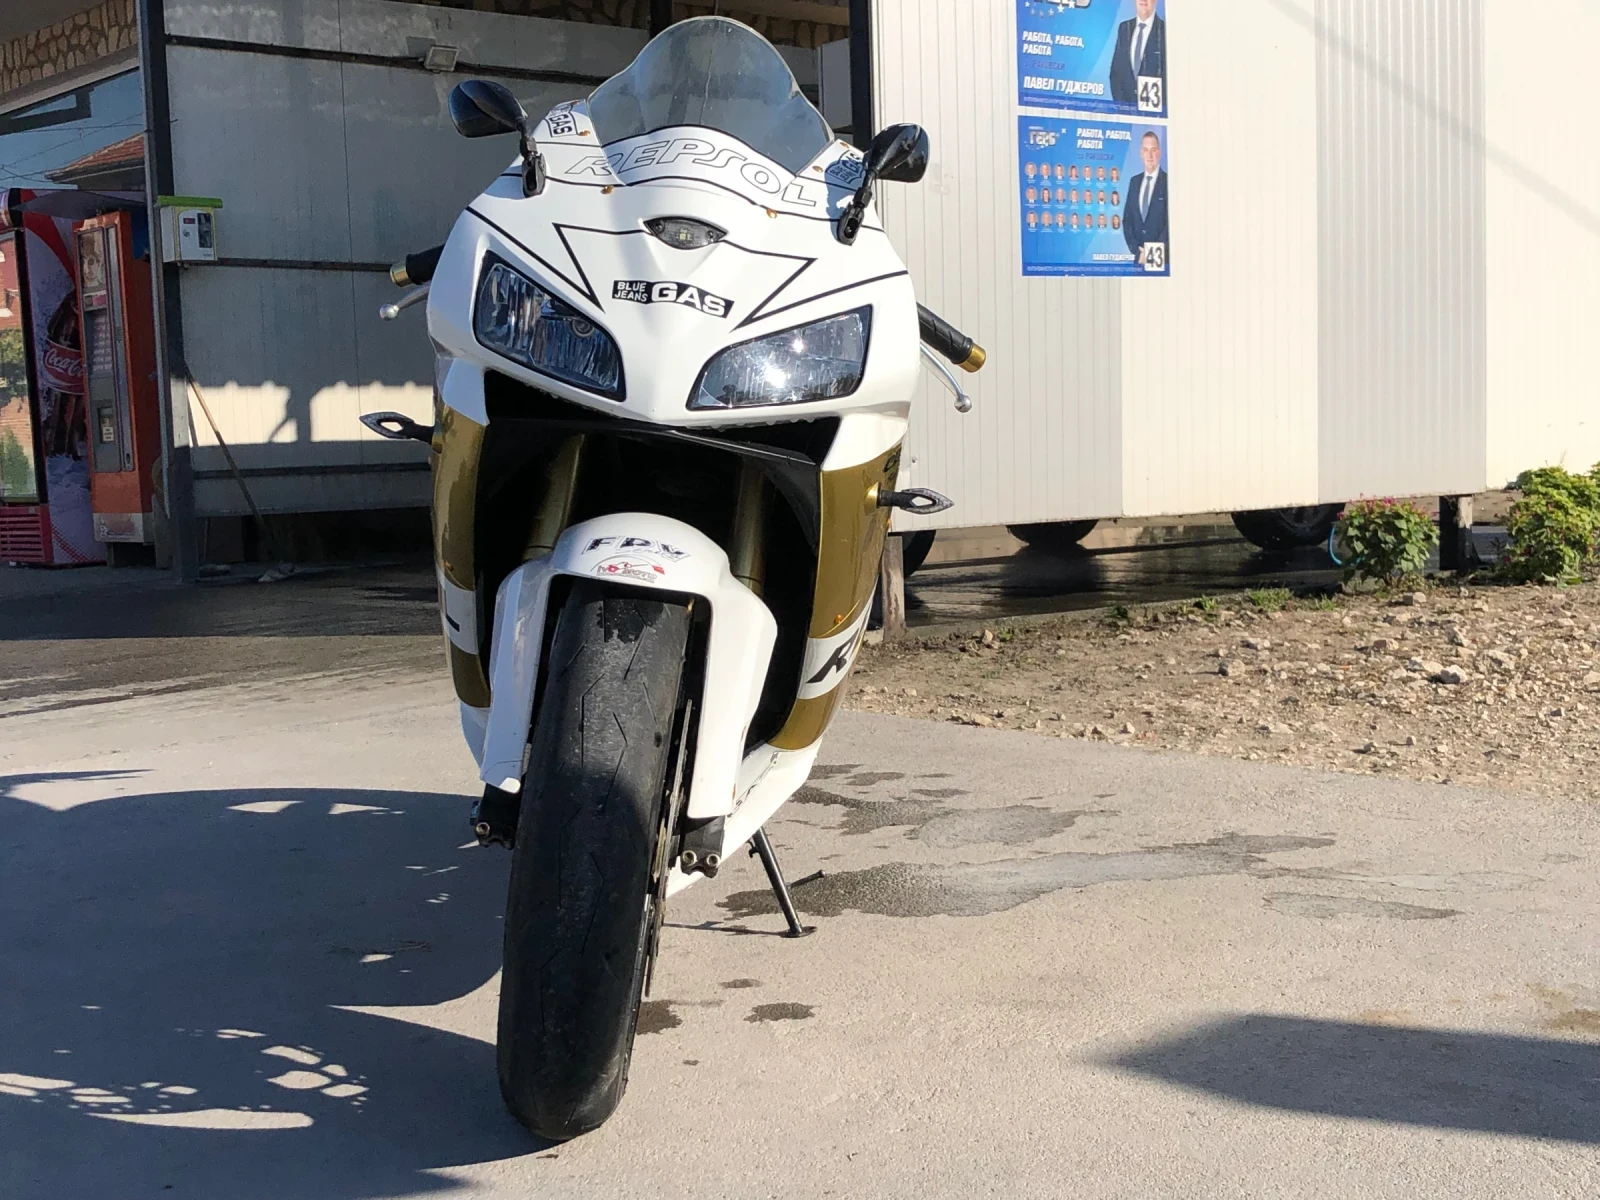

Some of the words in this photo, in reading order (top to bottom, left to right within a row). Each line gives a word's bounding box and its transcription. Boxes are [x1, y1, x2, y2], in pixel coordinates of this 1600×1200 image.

[1022, 30, 1053, 45] РАБОТА,
[1055, 34, 1084, 49] РАБОТА,
[1022, 44, 1051, 56] РАБОТА
[1023, 76, 1054, 91] ПАВЕЛ
[1056, 79, 1104, 95] ГУДЖЕРОВ
[1140, 81, 1161, 108] 43
[1076, 128, 1104, 139] РАБОТА,
[1105, 129, 1132, 141] РАБОТА,
[1077, 139, 1103, 149] РАБОТА
[564, 138, 816, 207] REPSOL
[1146, 246, 1163, 268] 43
[614, 290, 648, 302] JEANS
[617, 281, 647, 292] BLUE
[651, 282, 726, 317] GAS
